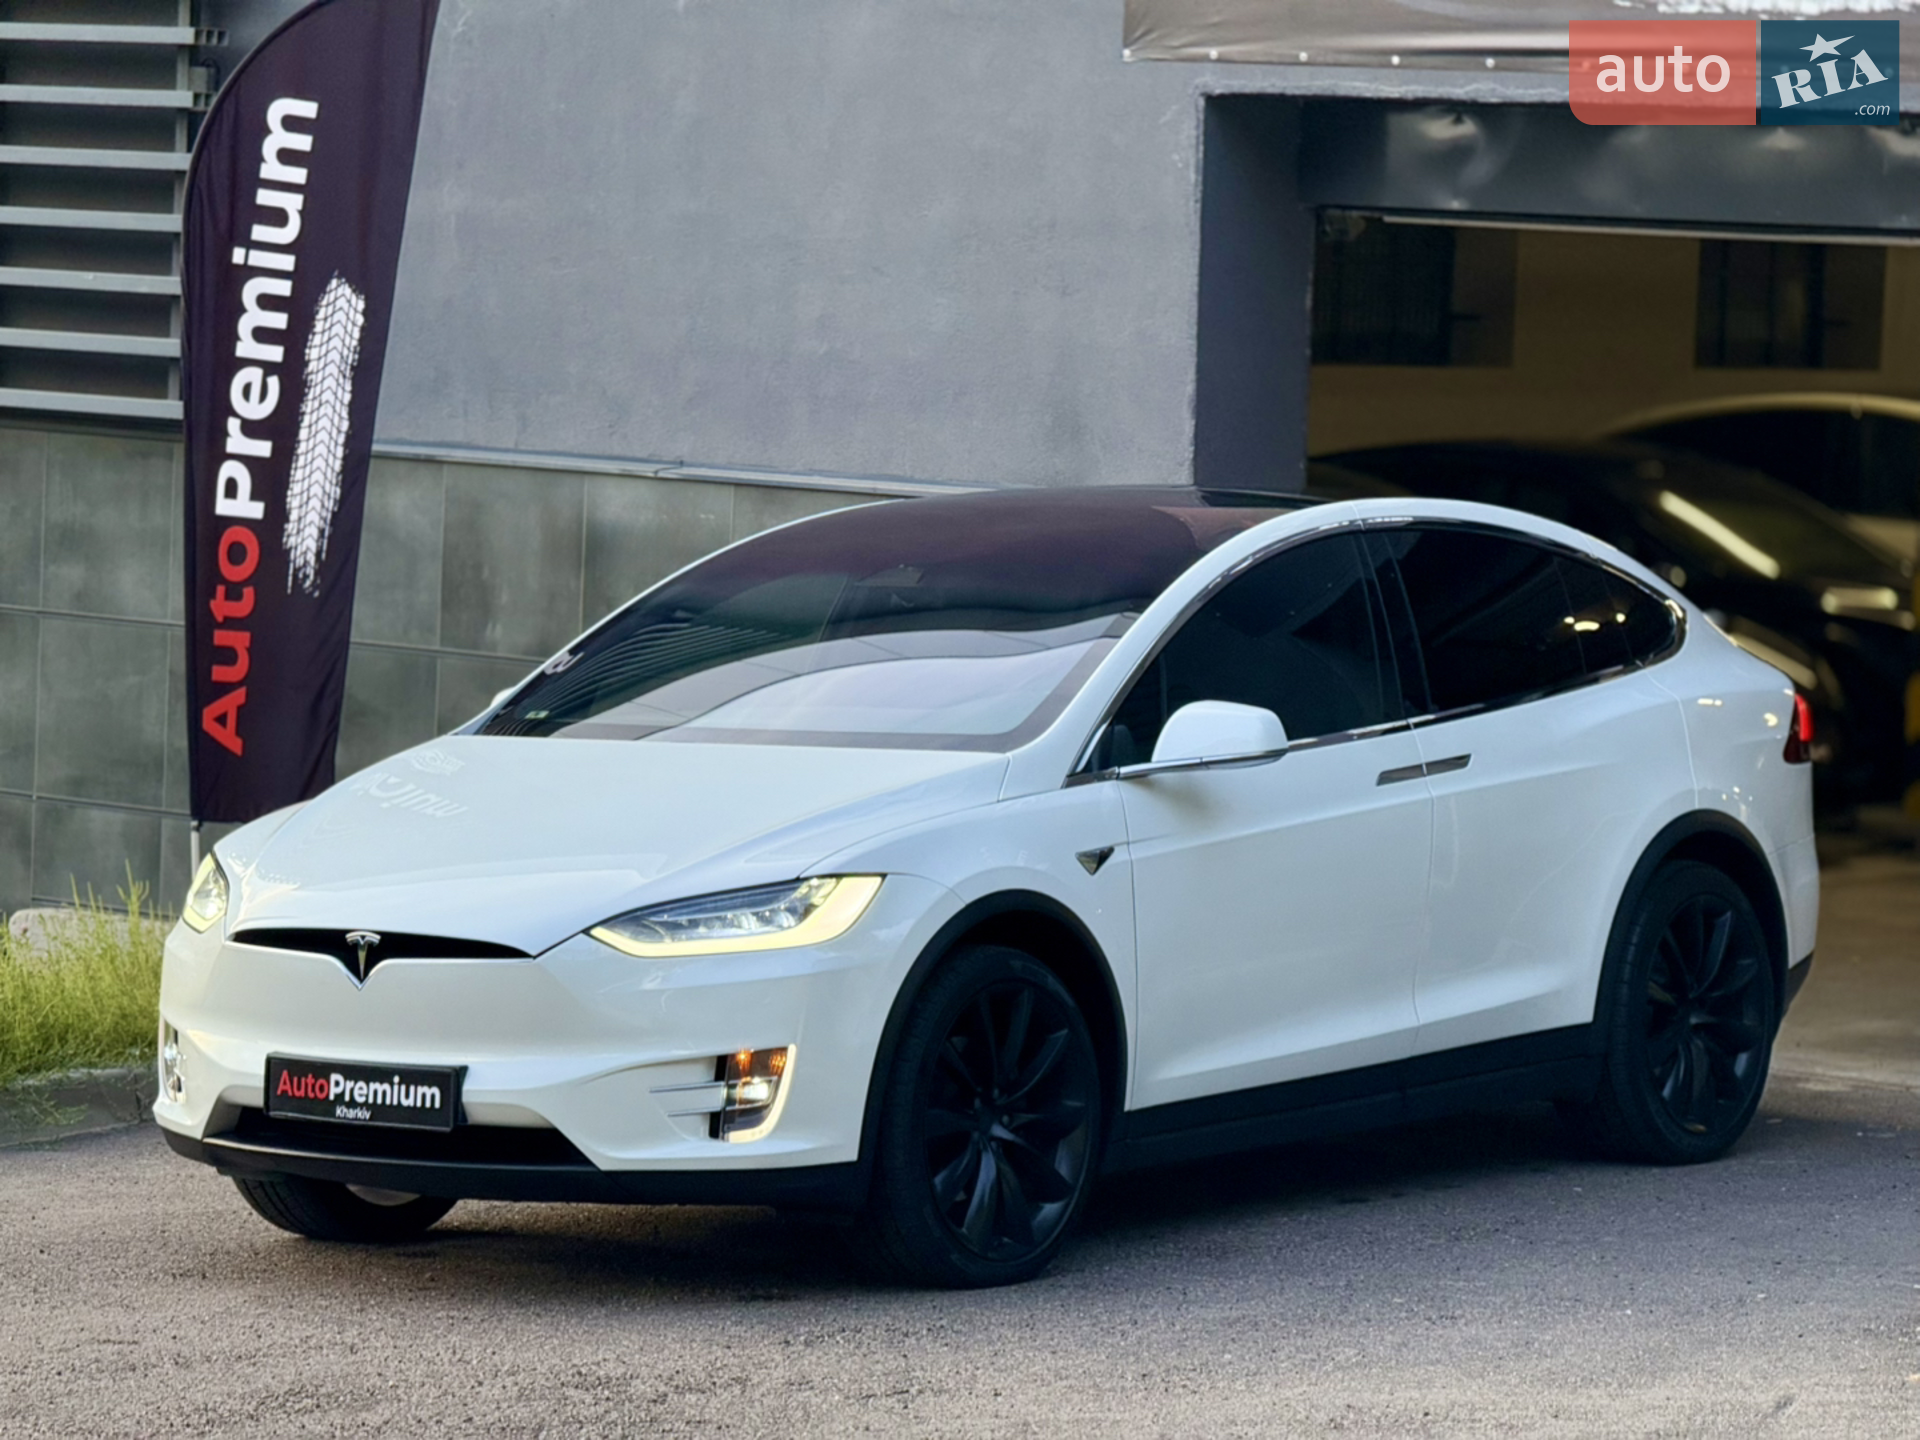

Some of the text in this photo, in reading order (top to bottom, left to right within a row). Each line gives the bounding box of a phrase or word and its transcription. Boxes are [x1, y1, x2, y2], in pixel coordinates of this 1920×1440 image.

[202, 97, 319, 756] AutoPremium
[276, 1069, 442, 1109] AutoPremium
[335, 1104, 372, 1120] Kharkiv
